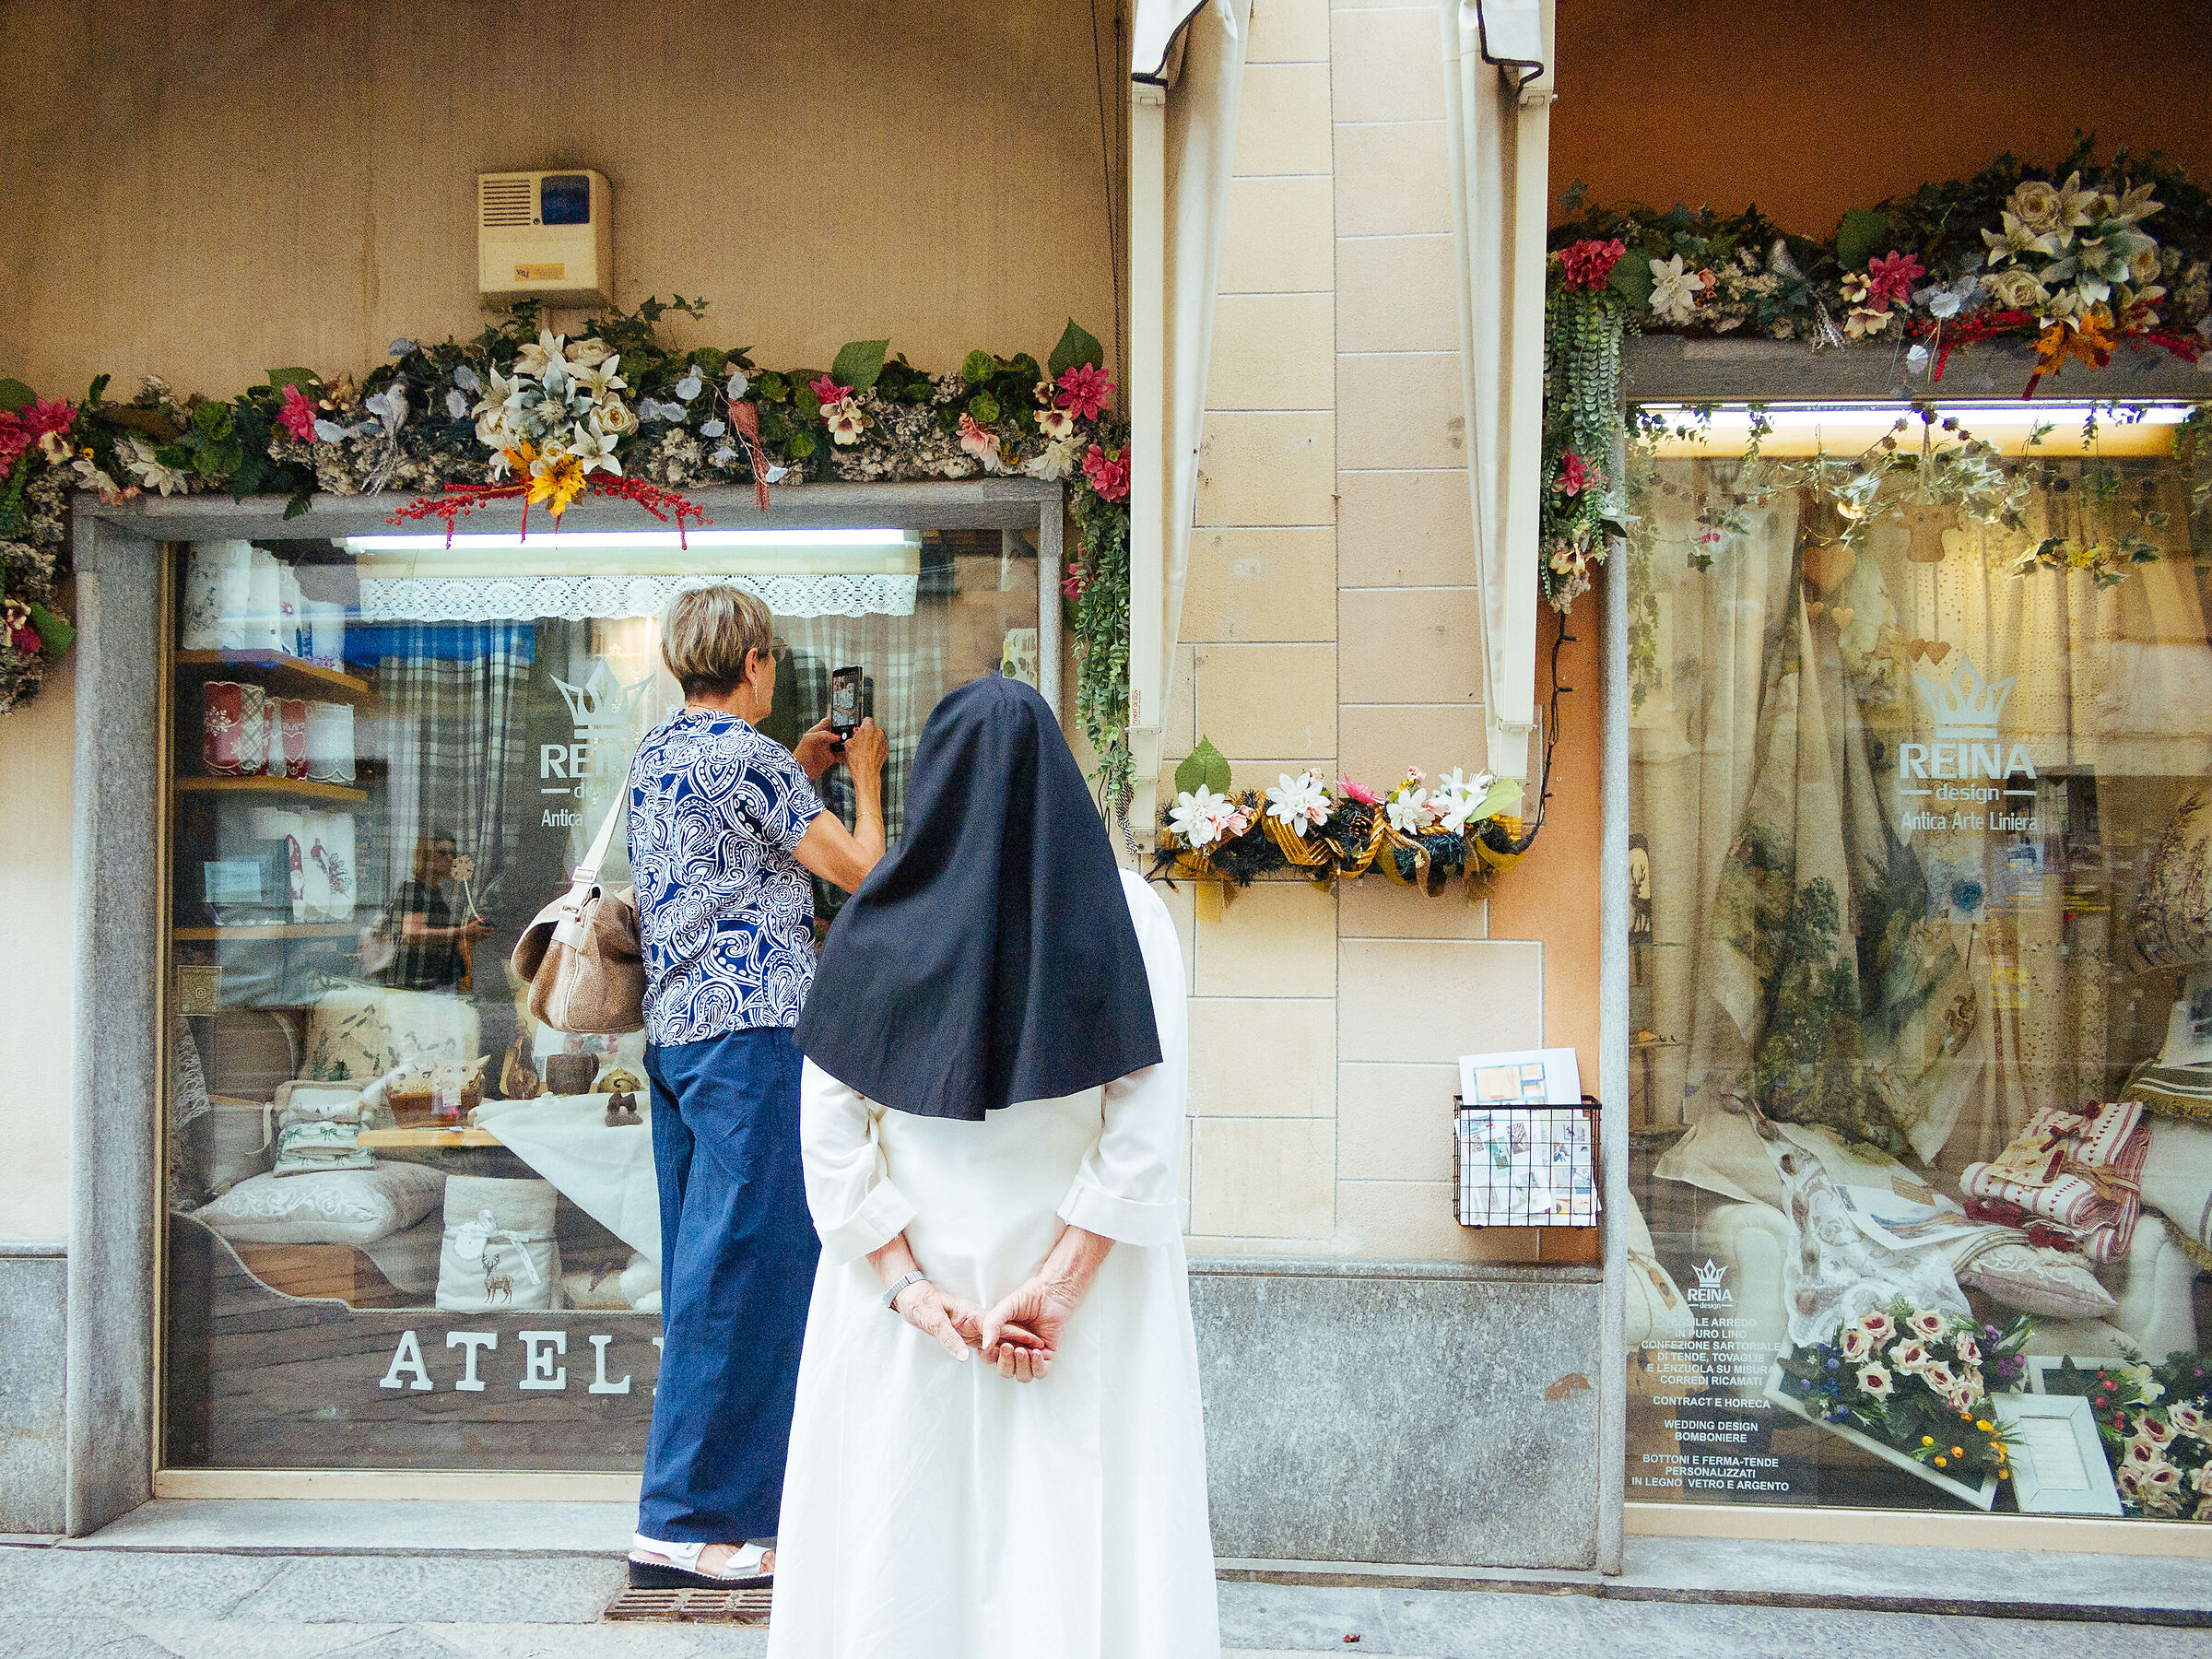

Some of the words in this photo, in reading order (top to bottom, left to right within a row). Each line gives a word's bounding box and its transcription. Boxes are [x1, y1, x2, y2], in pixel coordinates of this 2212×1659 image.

[1900, 743, 2037, 780] REINA
[1936, 783, 2000, 804] design
[541, 808, 582, 828] Antica
[1901, 811, 1947, 830] Antica
[1952, 811, 1984, 830] Arte
[1990, 811, 2038, 831] Liniera
[1688, 1288, 1733, 1301] REINA
[1700, 1301, 1721, 1310] design
[1711, 1318, 1757, 1327] ARREDO
[1675, 1329, 1686, 1338] IN
[1688, 1329, 1719, 1338] PURO
[1722, 1329, 1747, 1338] LINO
[1641, 1340, 1710, 1350] CONFEZIONE
[1712, 1341, 1782, 1351] SARTORIALE
[1657, 1352, 1668, 1361] DI
[1671, 1352, 1709, 1363] TENDE,
[1712, 1352, 1764, 1363] TOVAGLIE
[1647, 1363, 1654, 1372] E
[1656, 1363, 1714, 1373] LENZUOLA
[1716, 1364, 1731, 1374] SU
[1660, 1375, 1709, 1385] CORREDI
[1712, 1376, 1762, 1386] RICAMATI
[1653, 1396, 1712, 1406] CONTRACT
[1714, 1397, 1723, 1407] E
[1724, 1398, 1771, 1408] HORECA
[1664, 1419, 1714, 1430] WEDDING
[1717, 1421, 1759, 1432] DESIGN
[1675, 1431, 1747, 1443] BOMBONIERE
[1642, 1453, 1689, 1465] BOTTONI
[1692, 1455, 1700, 1465] E
[1701, 1455, 1779, 1467] FERMA-TENDE
[1665, 1466, 1756, 1478] PERSONALIZZATI
[1631, 1477, 1642, 1486] IN
[1645, 1477, 1682, 1488] LEGNO
[1688, 1478, 1724, 1489] VETRO
[1726, 1479, 1735, 1489] E
[1735, 1478, 1790, 1491] ARGENTO
